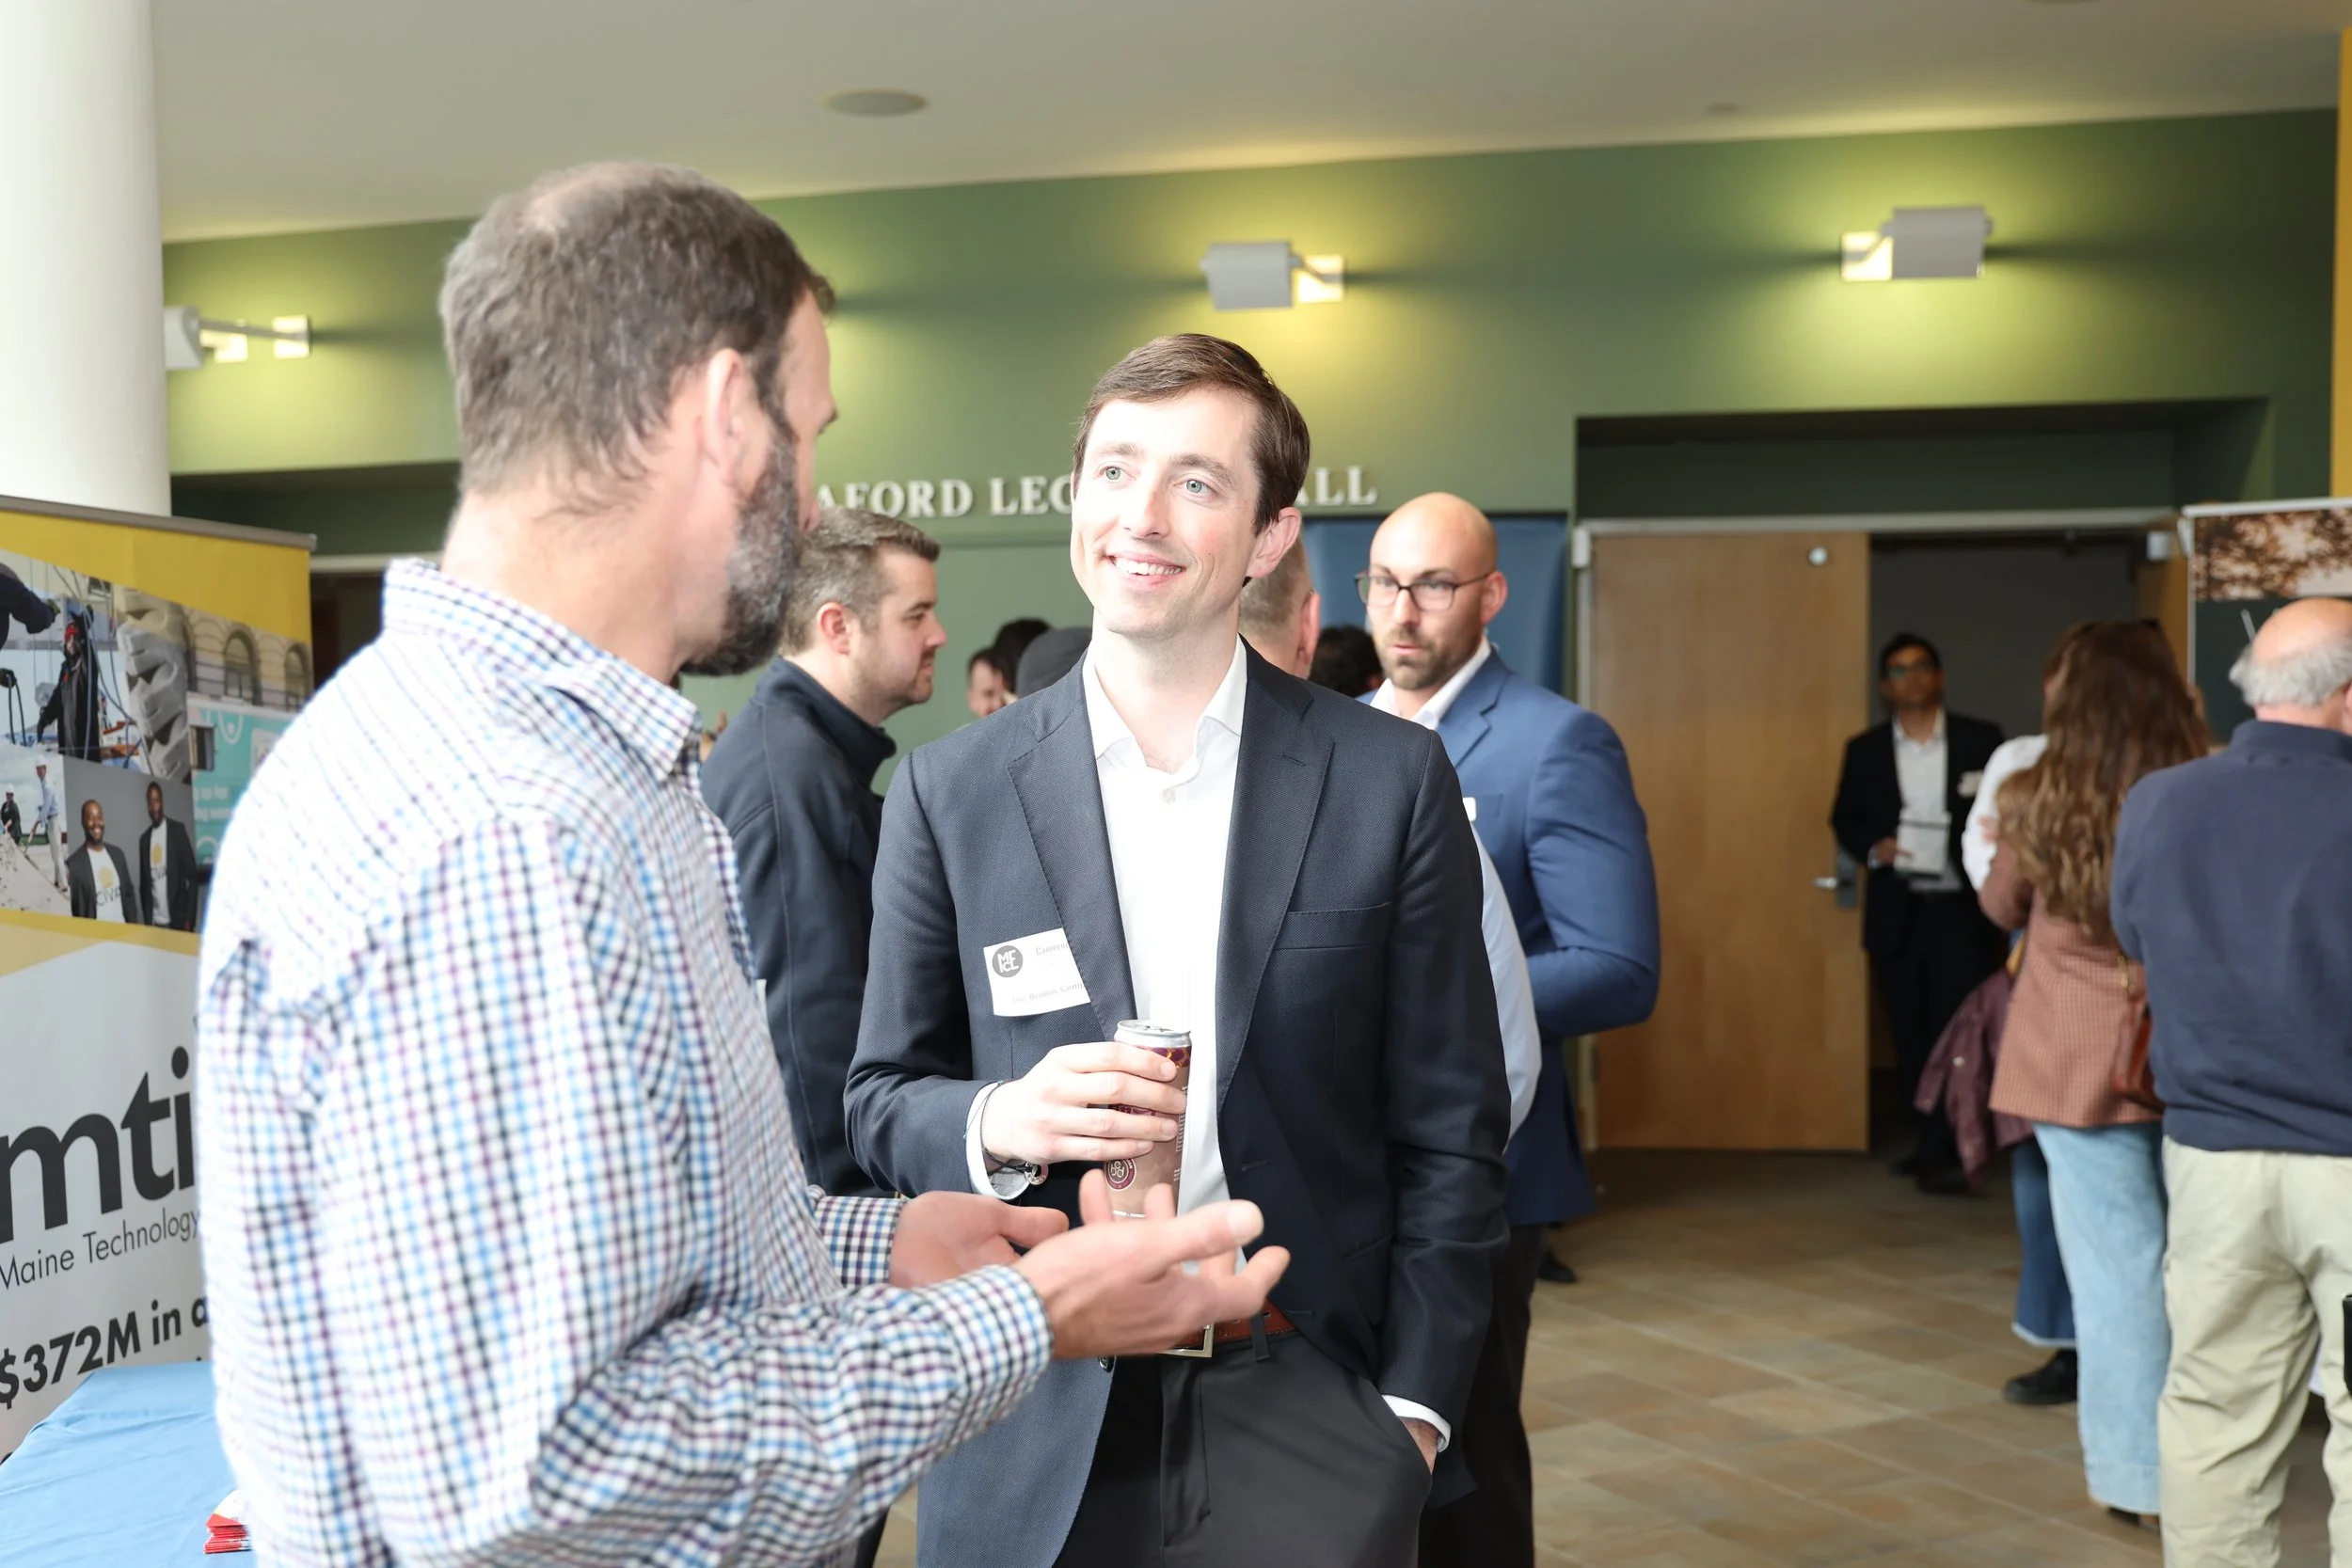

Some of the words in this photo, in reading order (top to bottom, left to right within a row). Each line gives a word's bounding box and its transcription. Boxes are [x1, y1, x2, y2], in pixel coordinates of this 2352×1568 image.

[0, 1046, 195, 1243] mti
[0, 1249, 74, 1290] Maine
[83, 1207, 200, 1263] Technology
[0, 1310, 141, 1410] $372M
[151, 1299, 182, 1346] in
